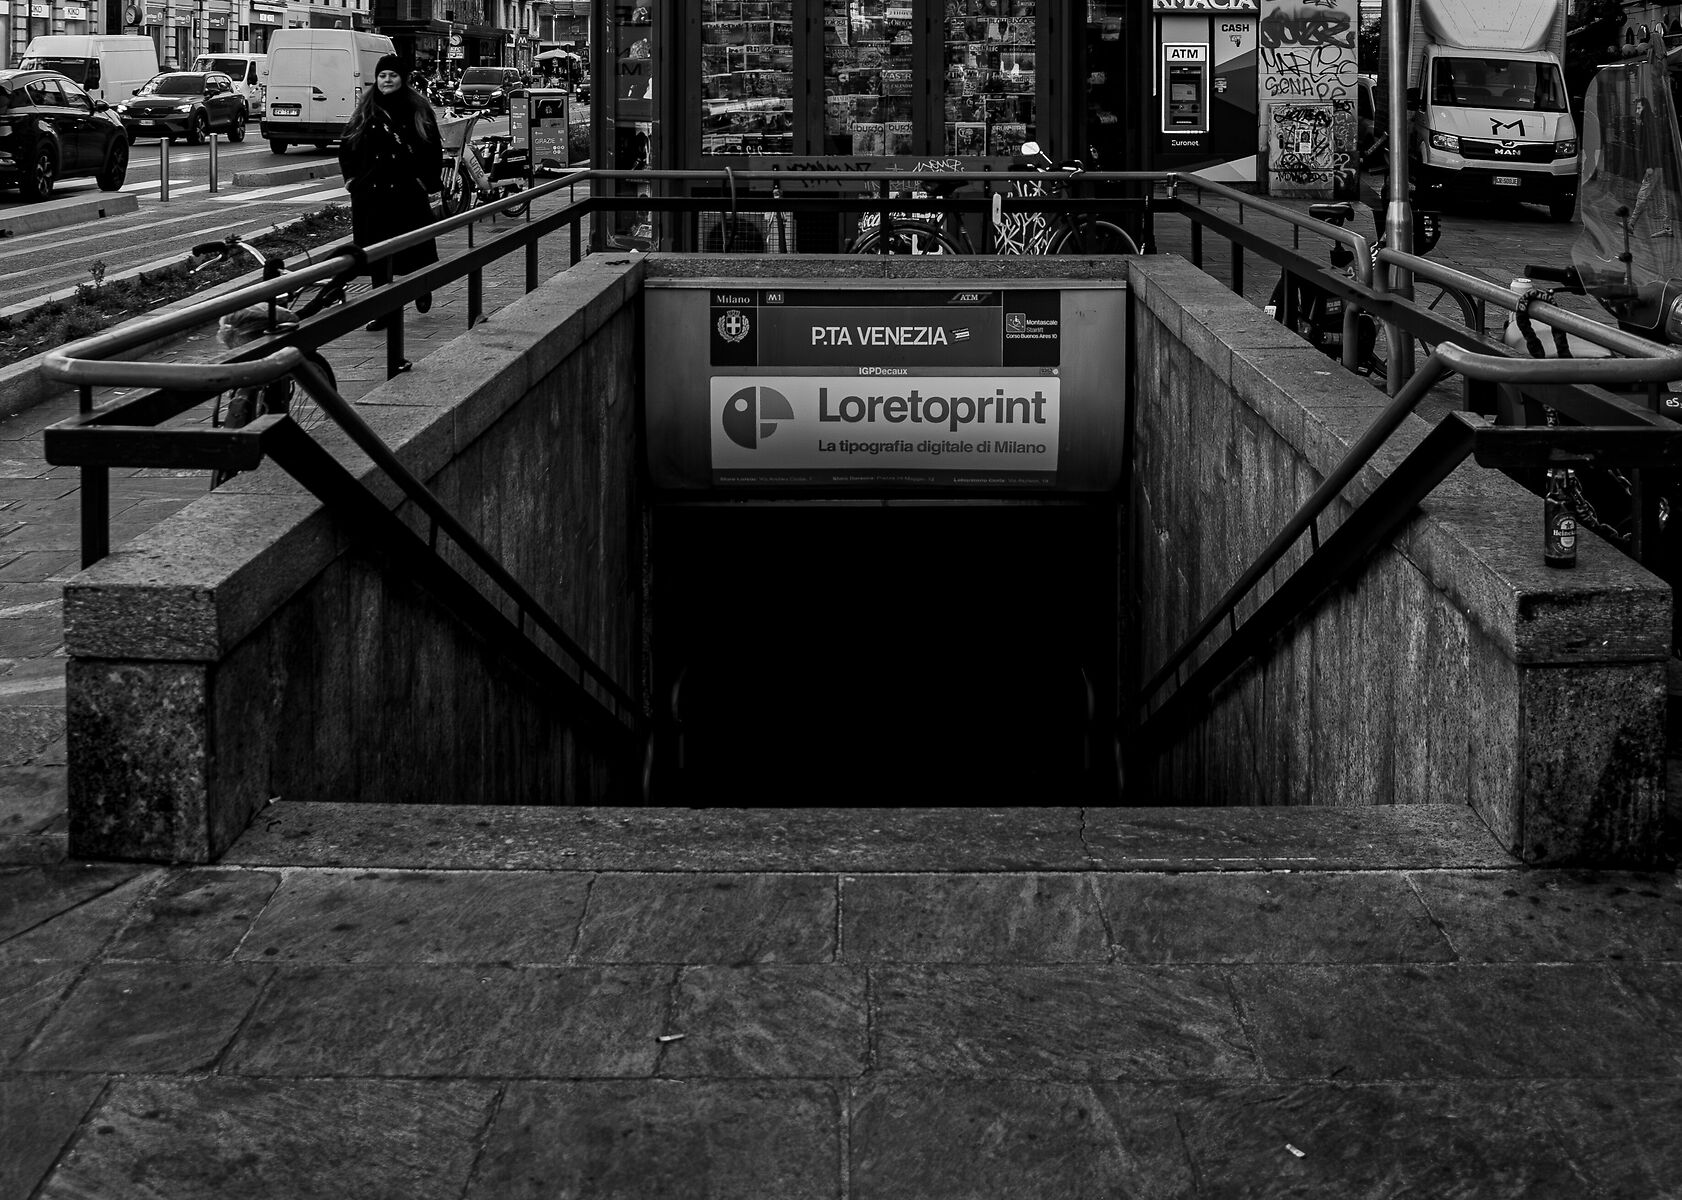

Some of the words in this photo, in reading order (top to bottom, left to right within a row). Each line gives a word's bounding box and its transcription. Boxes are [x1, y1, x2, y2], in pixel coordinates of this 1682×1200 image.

[1221, 24, 1250, 32] CASH
[1171, 49, 1199, 59] ATM
[1494, 148, 1522, 156] MAN
[716, 294, 751, 304] Milano
[767, 293, 783, 302] M1
[811, 326, 853, 346] P.TA
[856, 326, 948, 346] VENEZIA
[858, 366, 908, 376] IGPDecaux
[818, 387, 1047, 433] Loretoprint
[818, 439, 838, 454] La
[839, 438, 915, 457] tipografia
[917, 438, 974, 457] digitale
[976, 438, 992, 454] di
[994, 438, 1047, 454] Milano
